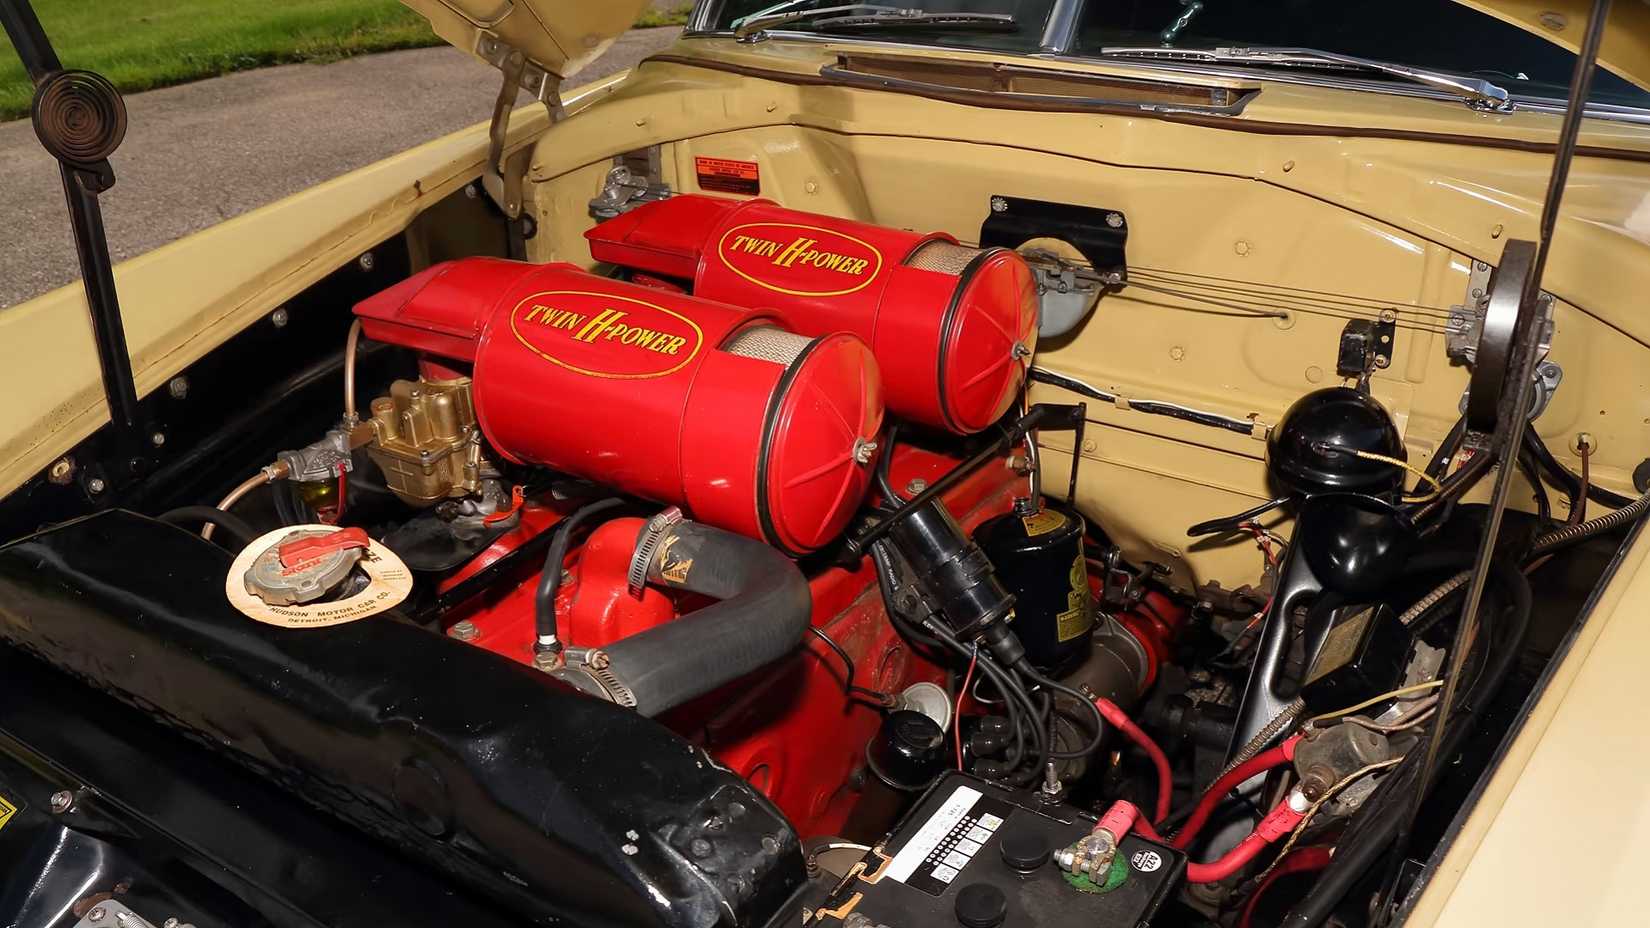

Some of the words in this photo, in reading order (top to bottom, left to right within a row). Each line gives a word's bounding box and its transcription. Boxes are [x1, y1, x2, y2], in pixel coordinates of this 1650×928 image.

[730, 235, 783, 257] TWIN
[772, 237, 869, 275] H-POWER
[523, 304, 587, 330] TWIN
[570, 308, 688, 355] H-POWER
[271, 607, 309, 617] HUDSON
[317, 607, 354, 617] MOTOR
[357, 599, 377, 609] CAR
[333, 605, 377, 621] MICHIGAN
